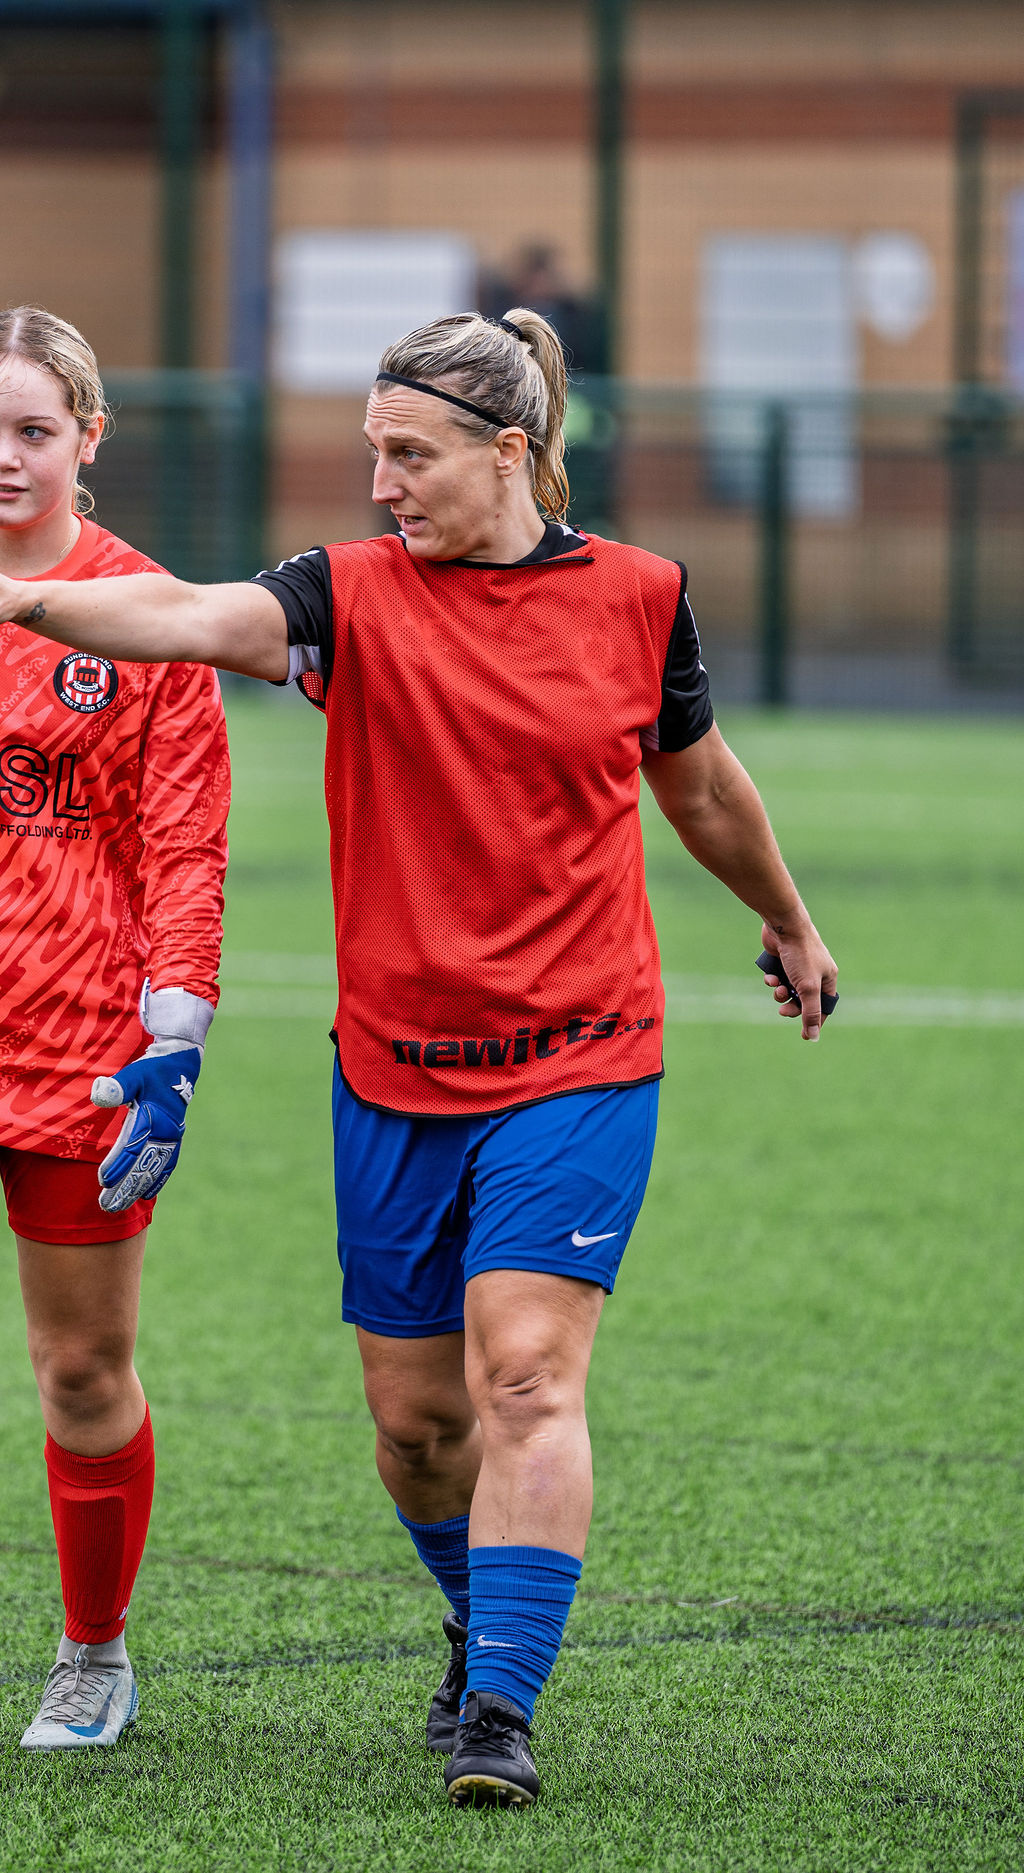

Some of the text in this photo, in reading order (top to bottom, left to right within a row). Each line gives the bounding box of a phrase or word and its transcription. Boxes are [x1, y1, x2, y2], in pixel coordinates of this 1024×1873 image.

[63, 653, 113, 671] SUNDEAND
[60, 691, 79, 709] WEST
[65, 827, 93, 841] LTD.
